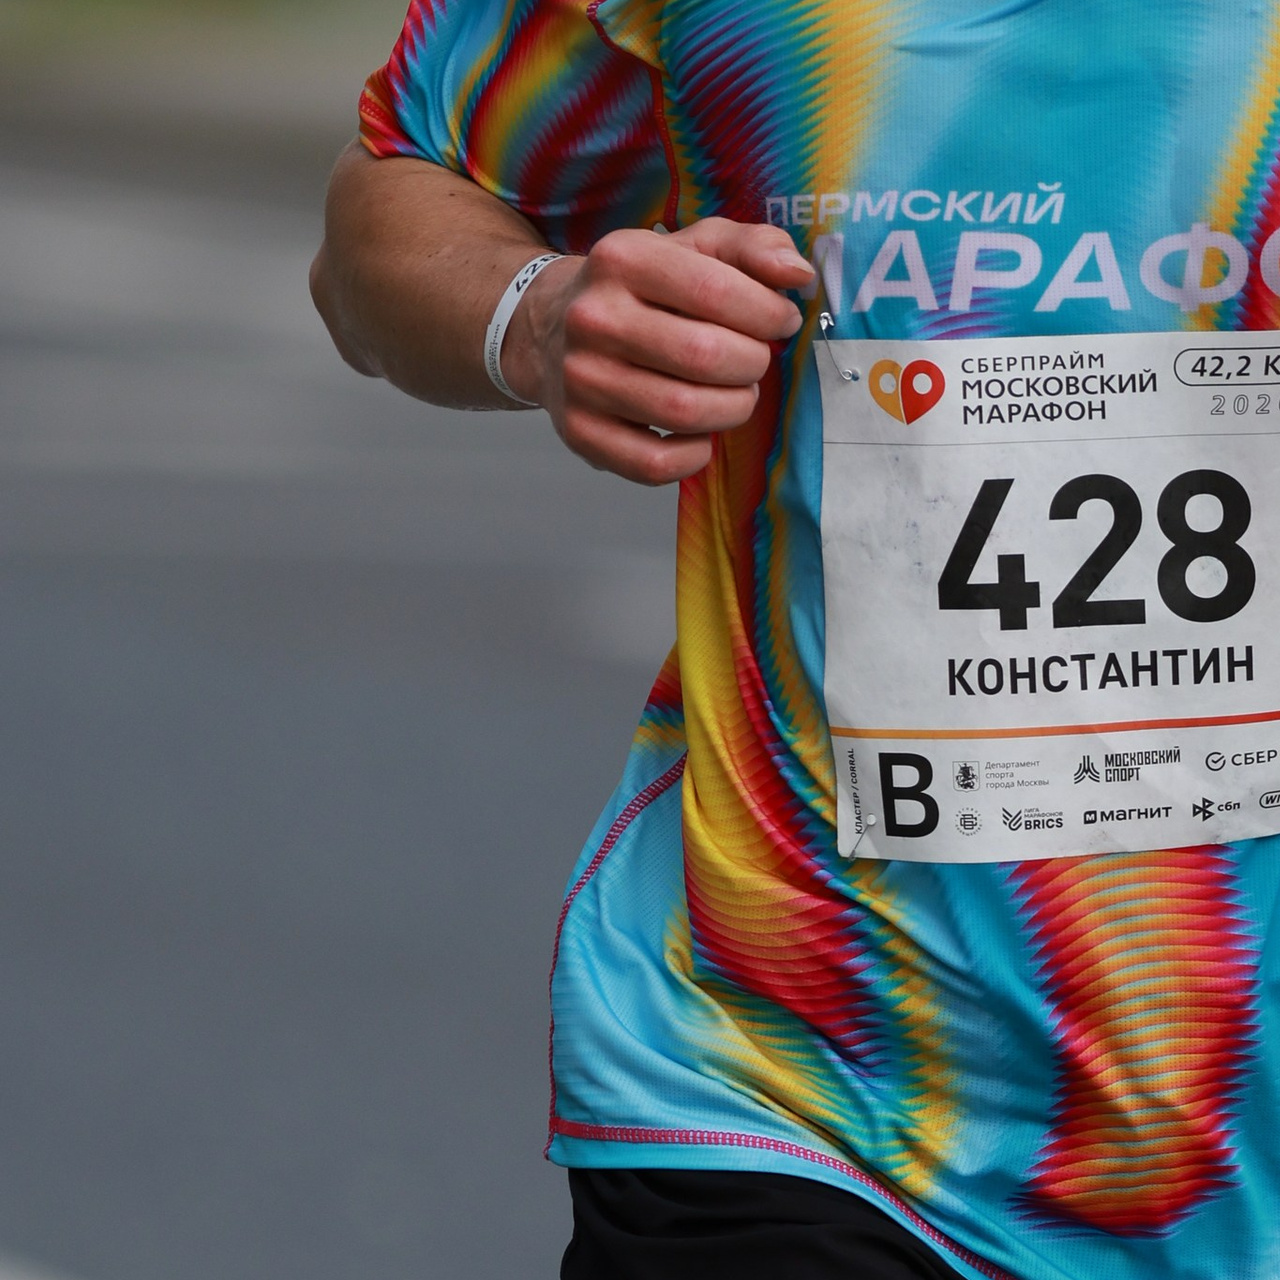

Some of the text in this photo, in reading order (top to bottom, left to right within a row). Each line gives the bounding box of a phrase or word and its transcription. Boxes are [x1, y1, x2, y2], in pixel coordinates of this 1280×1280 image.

[765, 182, 1065, 226] ПЕРМСКИЙ
[961, 351, 1104, 374] СБЕРПРАЙМ
[1190, 356, 1251, 381] 42,2
[961, 369, 1158, 400] МОСКОВСКИЙ
[962, 400, 1107, 425] МАРАФОН
[938, 469, 1256, 631] 428
[948, 646, 1255, 696] КОНСТАНТИН
[848, 748, 858, 785] CORRAL
[984, 761, 1041, 770] Департамент
[1104, 746, 1181, 768] МОСКОВСКИЙ
[1231, 749, 1278, 766] СБЕР
[985, 772, 1015, 780] спорта
[985, 781, 1015, 790] города
[1105, 767, 1141, 783] СПОРТ
[878, 752, 940, 838] B
[1217, 801, 1241, 812] сбп
[853, 792, 863, 835] КЛАСТЕР
[1024, 818, 1064, 830] BRICS
[1100, 806, 1173, 822] магнит
